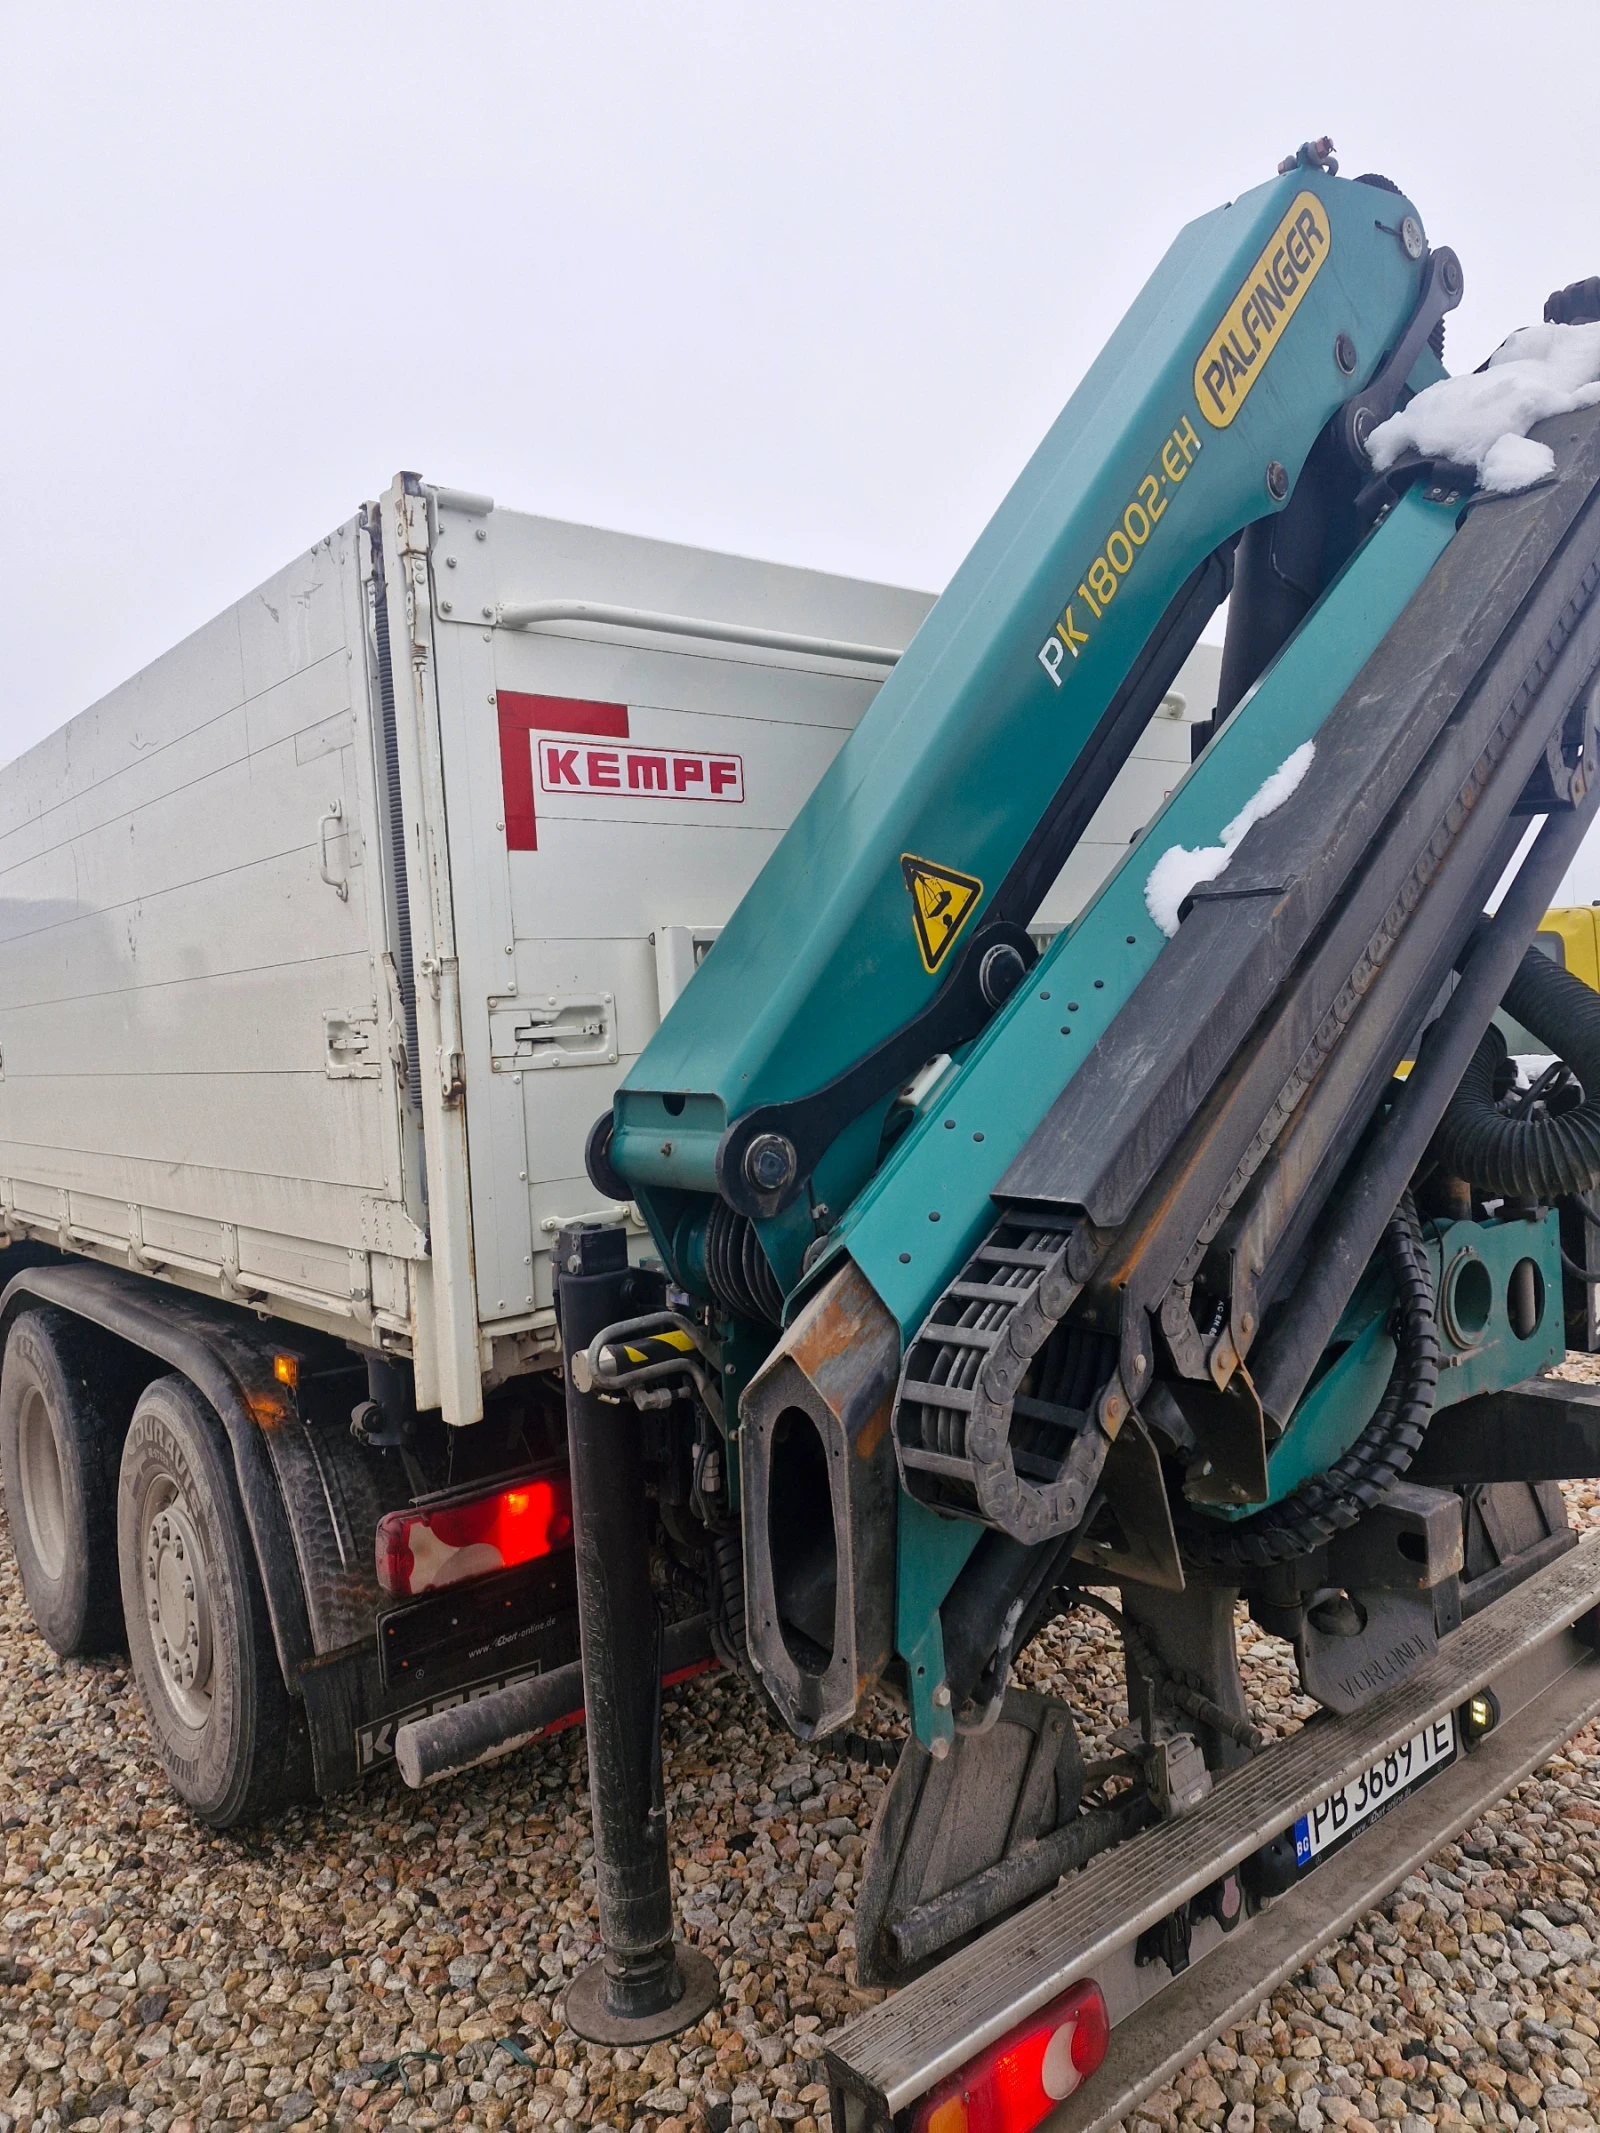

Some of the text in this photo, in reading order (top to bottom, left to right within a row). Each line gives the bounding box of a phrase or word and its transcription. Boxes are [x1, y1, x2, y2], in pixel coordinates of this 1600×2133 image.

[1202, 207, 1325, 414] PALFINGER
[1037, 605, 1089, 687] PK
[546, 747, 737, 794] KEMPF
[1312, 1787, 1349, 1845] PB
[1354, 1739, 1412, 1812] 3689
[1296, 1836, 1310, 1857] BG
